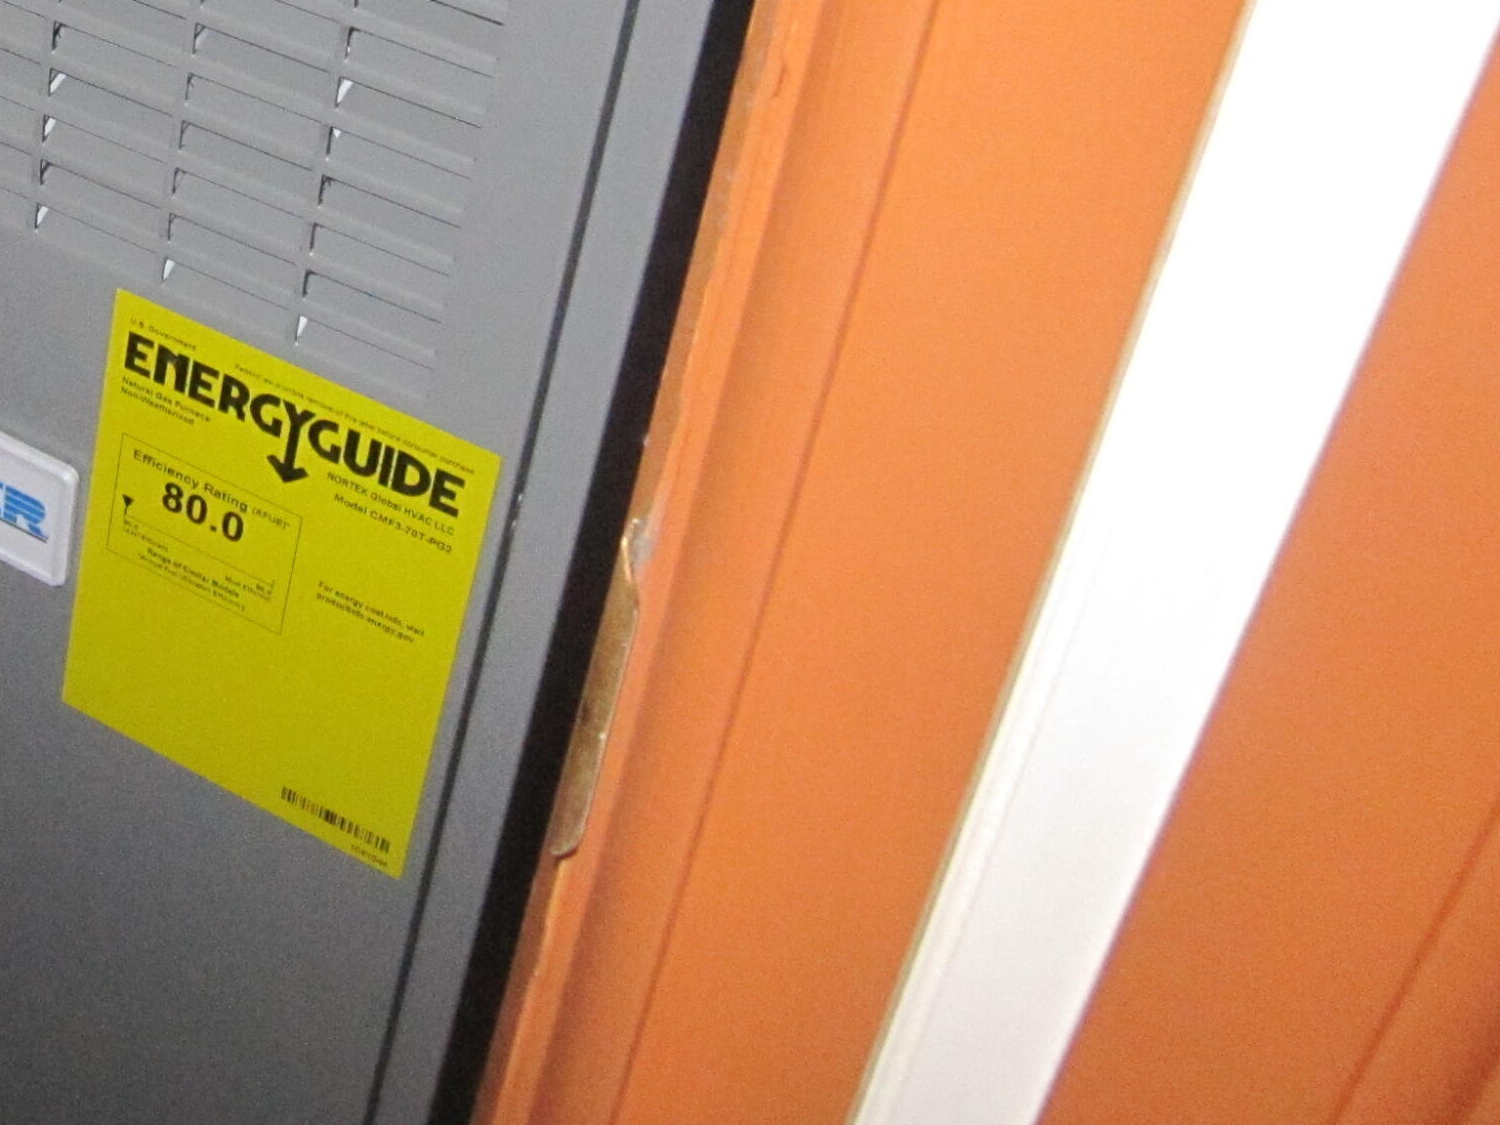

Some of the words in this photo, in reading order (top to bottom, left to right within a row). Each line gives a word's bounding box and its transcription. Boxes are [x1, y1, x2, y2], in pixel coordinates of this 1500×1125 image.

[120, 386, 194, 425] Non-Weatherized
[122, 376, 153, 396] Natural
[155, 391, 172, 405] Gas
[174, 400, 211, 422] Furnace
[124, 331, 466, 518] ENERGYGUIDE
[132, 448, 198, 489] Efficiency
[203, 481, 249, 514] Rating
[326, 471, 368, 496] NORTEK
[369, 491, 401, 512] Global
[403, 506, 432, 526] HVAC
[434, 520, 455, 536] LLC
[333, 493, 367, 515] Model
[162, 481, 245, 543] 80.0
[318, 580, 333, 593] For
[333, 589, 363, 609] energy
